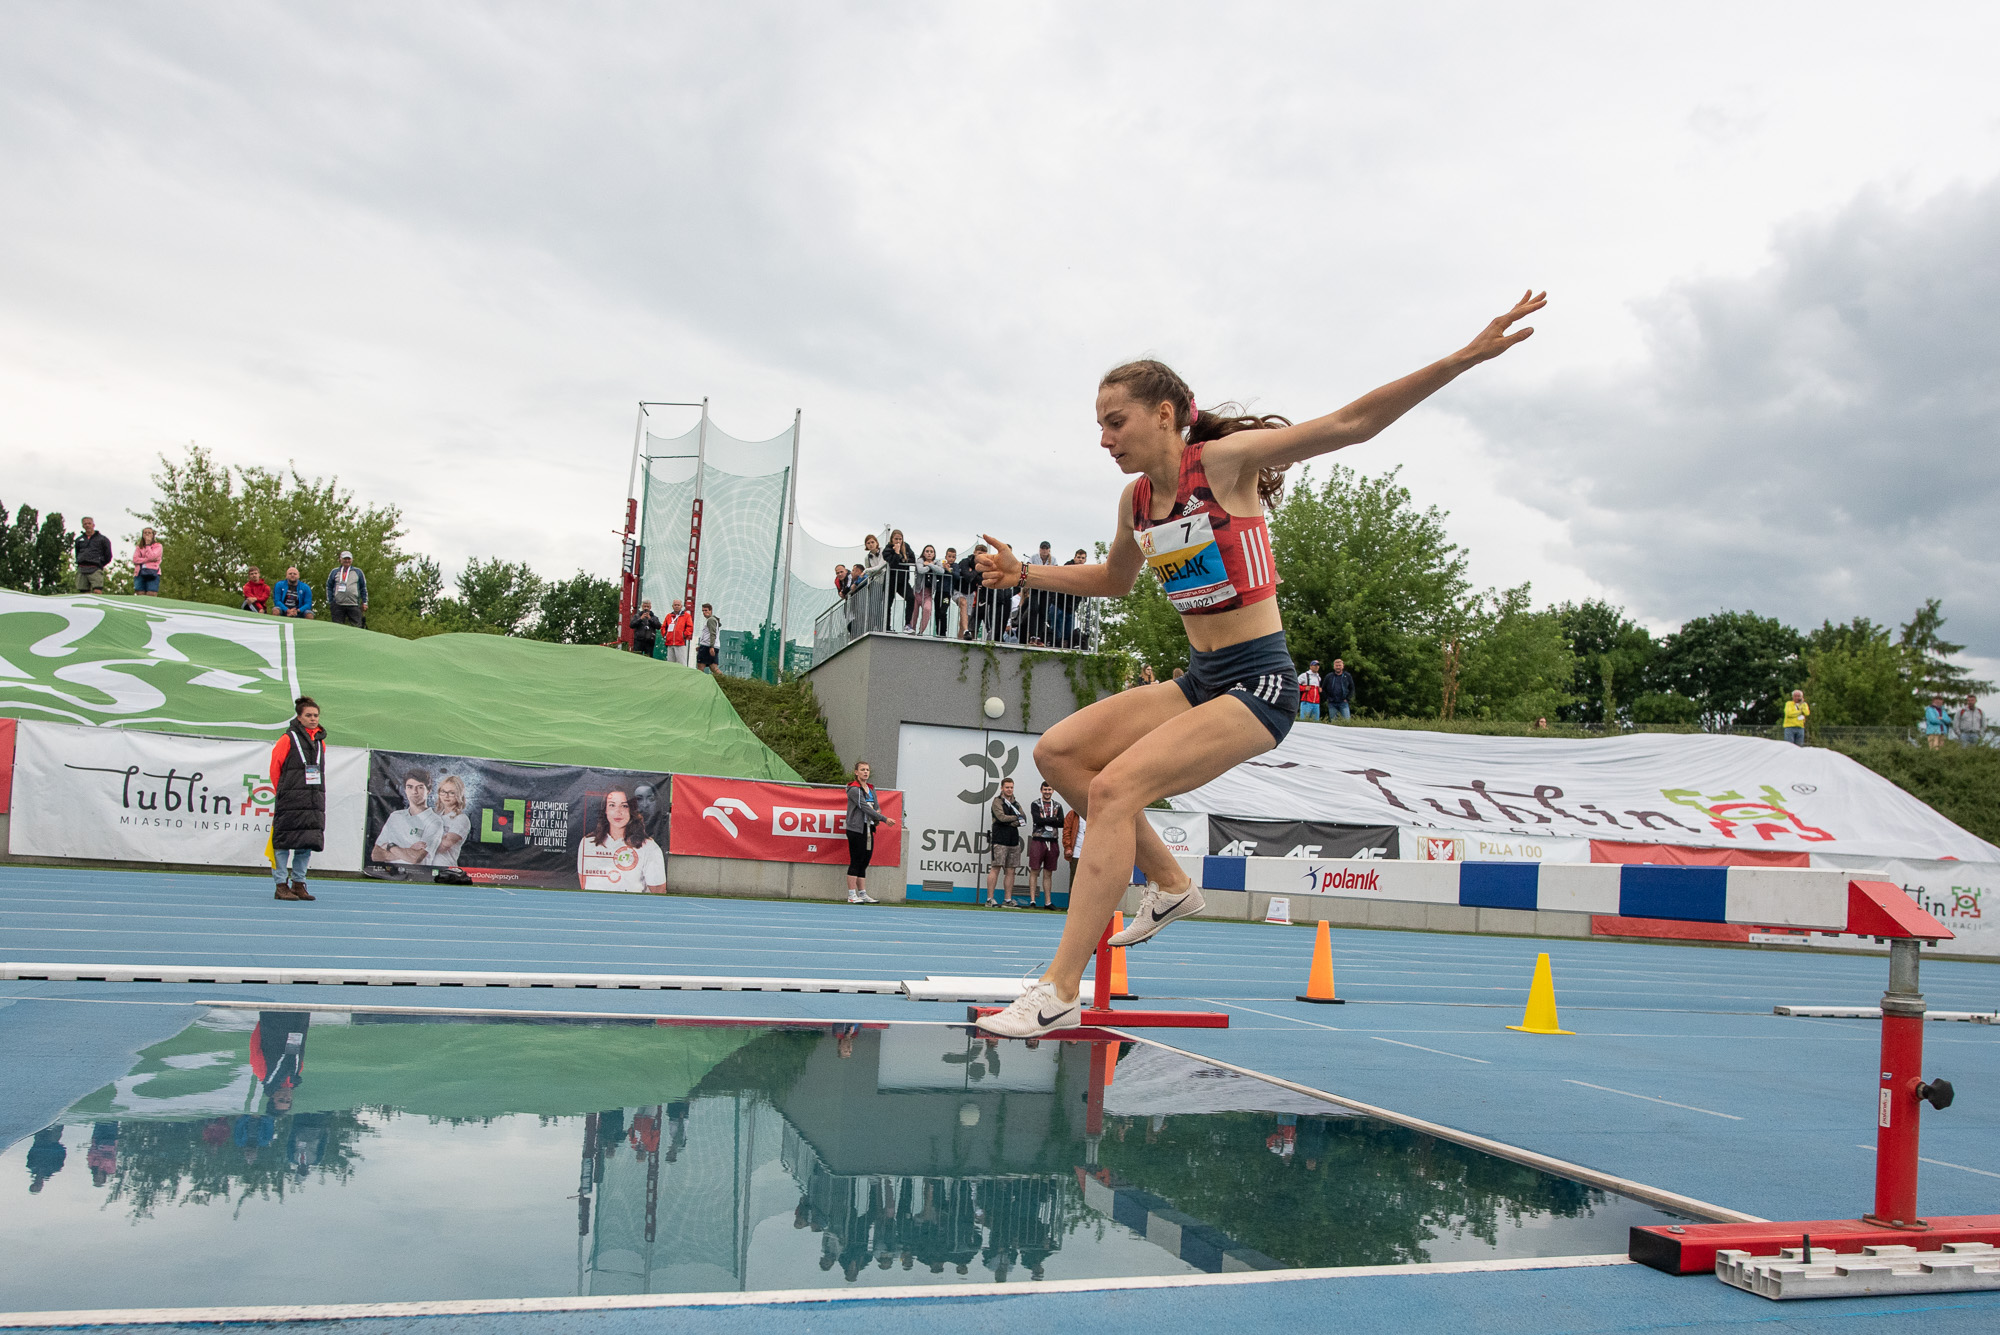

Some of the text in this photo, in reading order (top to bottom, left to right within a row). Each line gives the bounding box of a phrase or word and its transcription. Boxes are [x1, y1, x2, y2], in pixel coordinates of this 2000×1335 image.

[1182, 501, 1205, 517] adidas
[1180, 521, 1192, 544] 7
[1193, 596, 1215, 609] 2021
[526, 800, 569, 811] AKADEMICKIE
[526, 809, 569, 820] CENTRUM
[119, 815, 271, 833] MIASTO INSPIRAC
[525, 818, 568, 829] SZKOLENIA
[778, 811, 847, 834] ORLE
[525, 827, 568, 838] SPORTOWEGO
[524, 836, 567, 847] W LUBLINIE
[1166, 844, 1190, 852] OYOTA
[1480, 841, 1543, 858] PZLA 100
[1321, 867, 1380, 894] polanik
